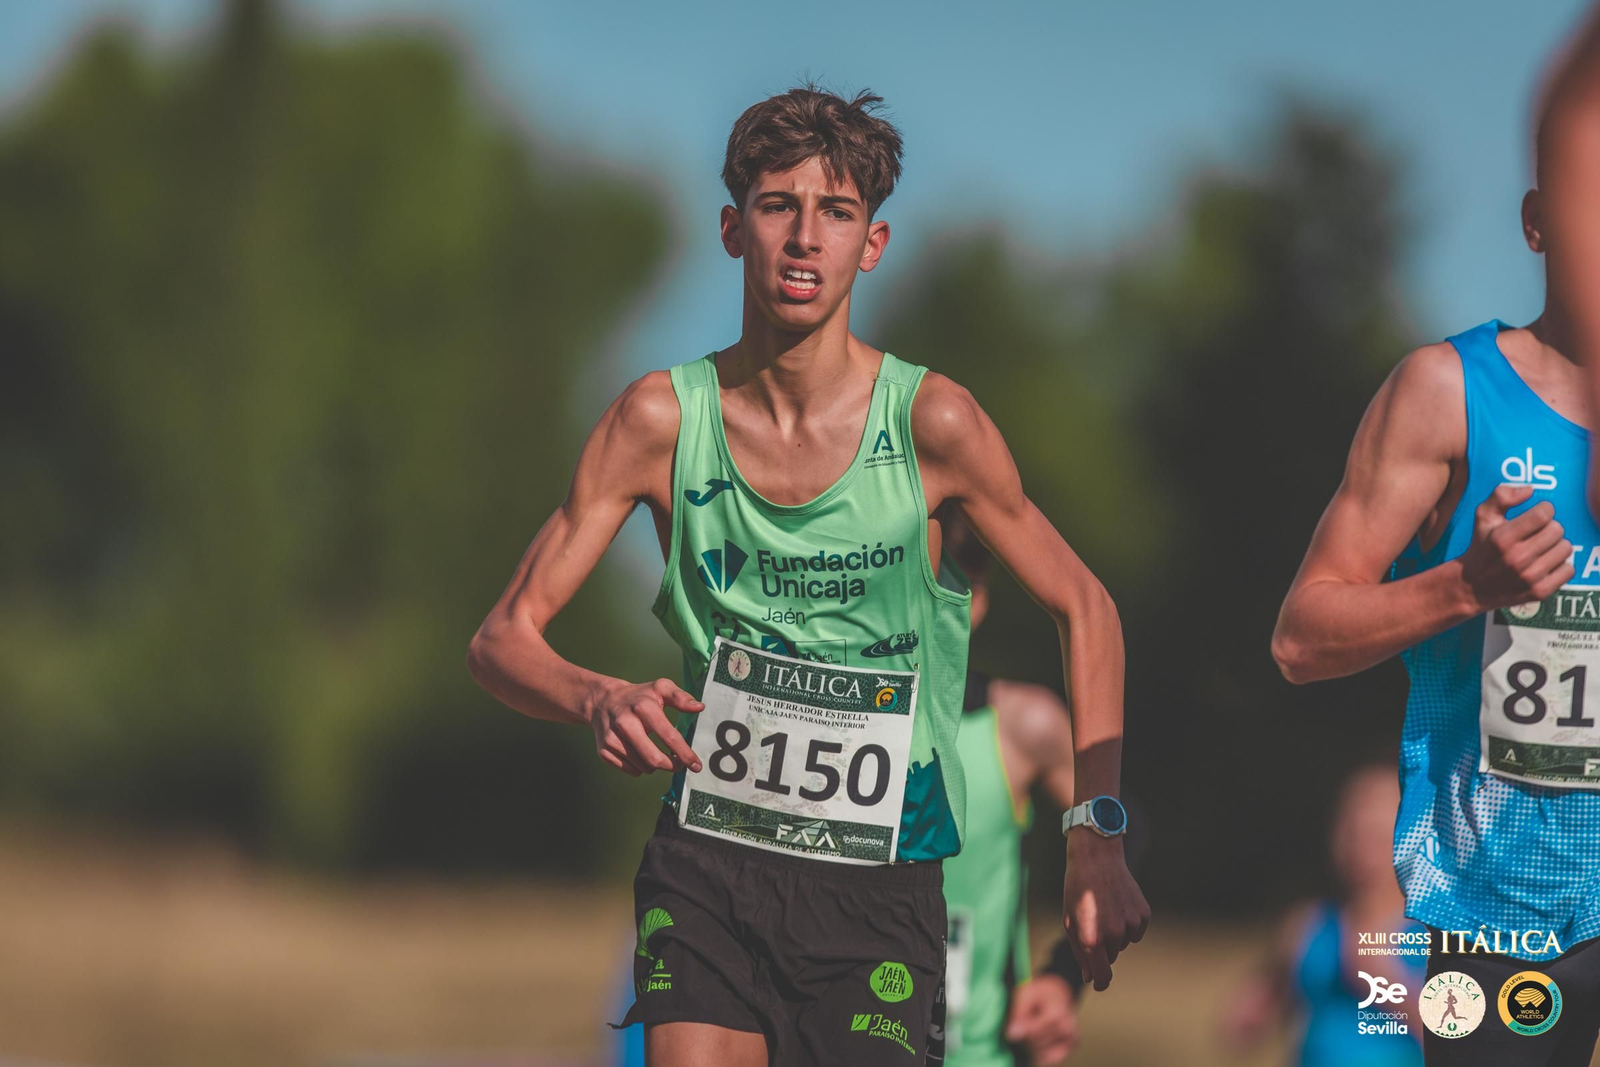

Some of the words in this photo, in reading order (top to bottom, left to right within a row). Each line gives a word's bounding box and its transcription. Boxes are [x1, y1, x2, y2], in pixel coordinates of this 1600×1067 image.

[885, 453, 905, 461] Andaluc
[757, 542, 904, 573] Fundación
[761, 574, 866, 605] Unicaja
[762, 608, 806, 625] Jaén
[1555, 591, 1600, 618] ITÁ
[762, 663, 863, 699] ITÁLICA
[762, 683, 811, 698] INTERNATIONAL
[813, 693, 832, 702] CROSS
[833, 697, 862, 705] COUNTRY
[1503, 660, 1595, 728] 81
[747, 695, 772, 707] JESUS
[773, 700, 824, 717] HERRADOR
[825, 711, 869, 722] ESTRELLA
[799, 715, 830, 726] PARAISO
[831, 720, 866, 730] INTERIOR
[708, 719, 891, 807] 8150
[719, 828, 757, 842] FEDERACIÓN
[758, 838, 793, 851] ANDALUZA
[805, 848, 842, 858] ATLETISMO
[850, 835, 884, 847] docunova
[647, 979, 672, 993] Jaén
[870, 1014, 908, 1041] Jaén
[868, 1030, 895, 1040] PARAÍSO
[895, 1036, 917, 1056] INTERIOR
